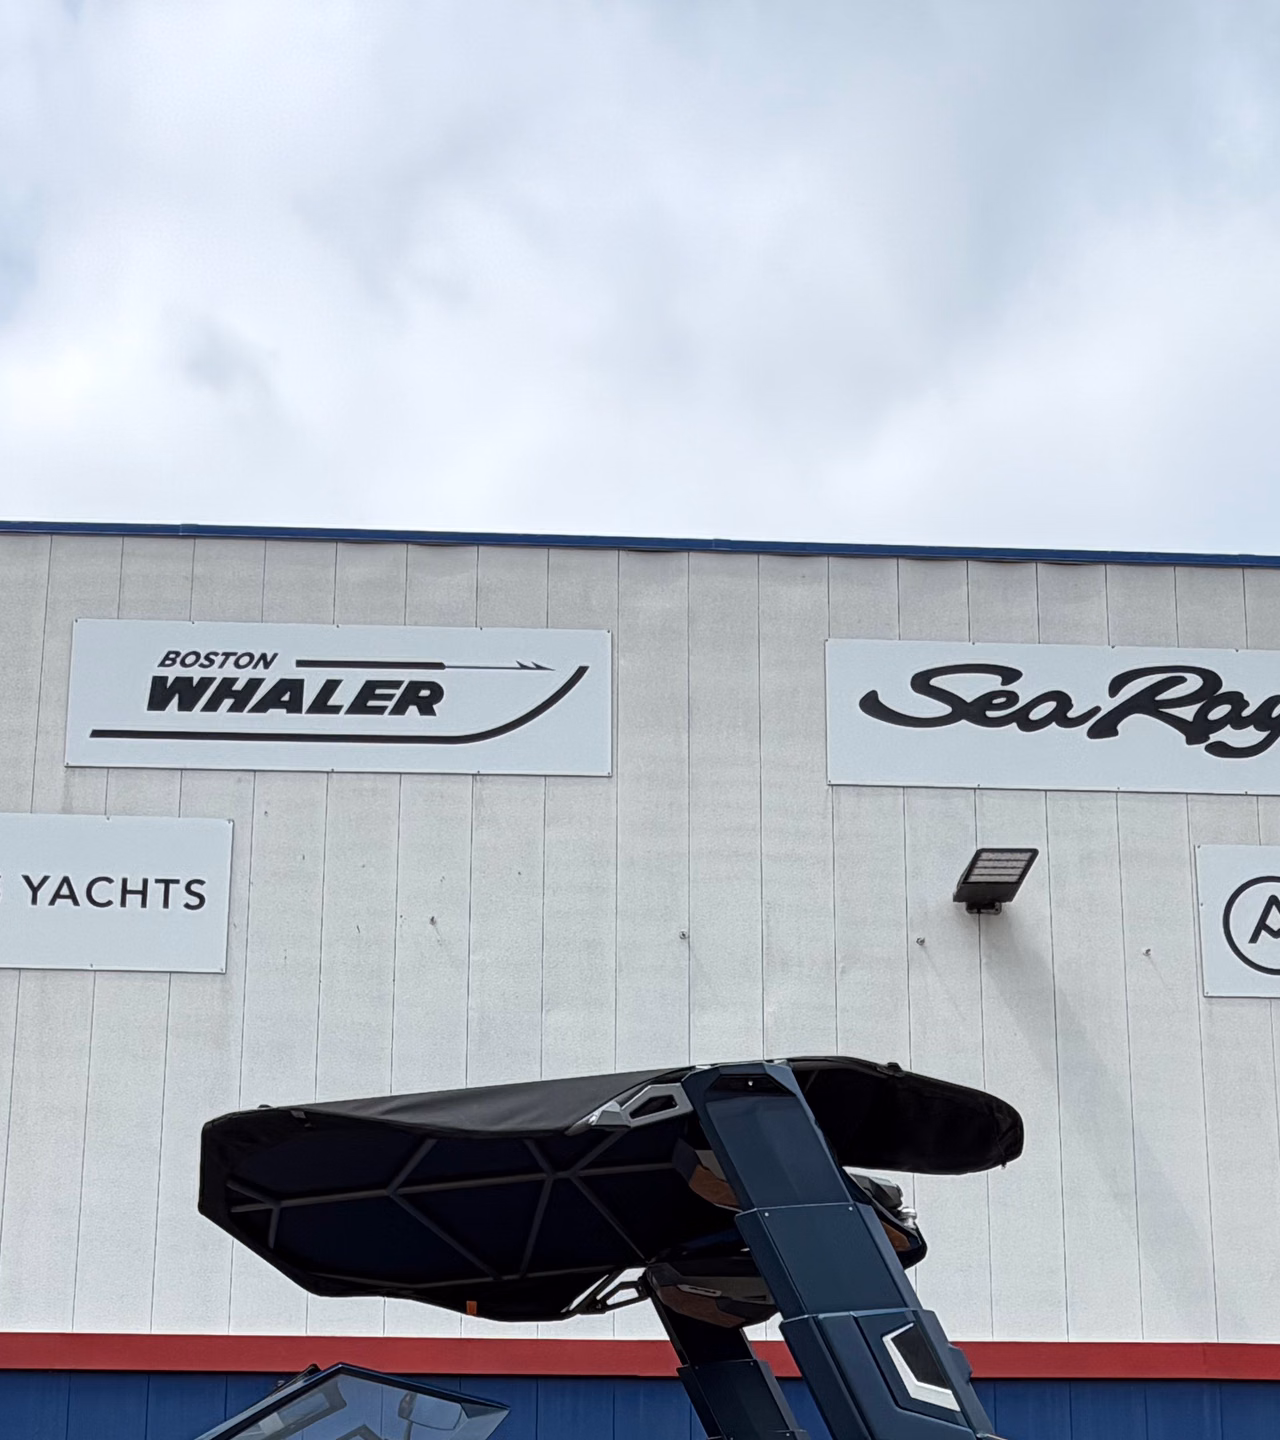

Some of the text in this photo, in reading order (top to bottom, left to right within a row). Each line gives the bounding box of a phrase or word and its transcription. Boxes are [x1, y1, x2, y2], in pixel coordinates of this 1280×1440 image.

[157, 650, 278, 670] BOSTON
[147, 675, 444, 716] WHALER
[21, 873, 207, 911] YACHTS
